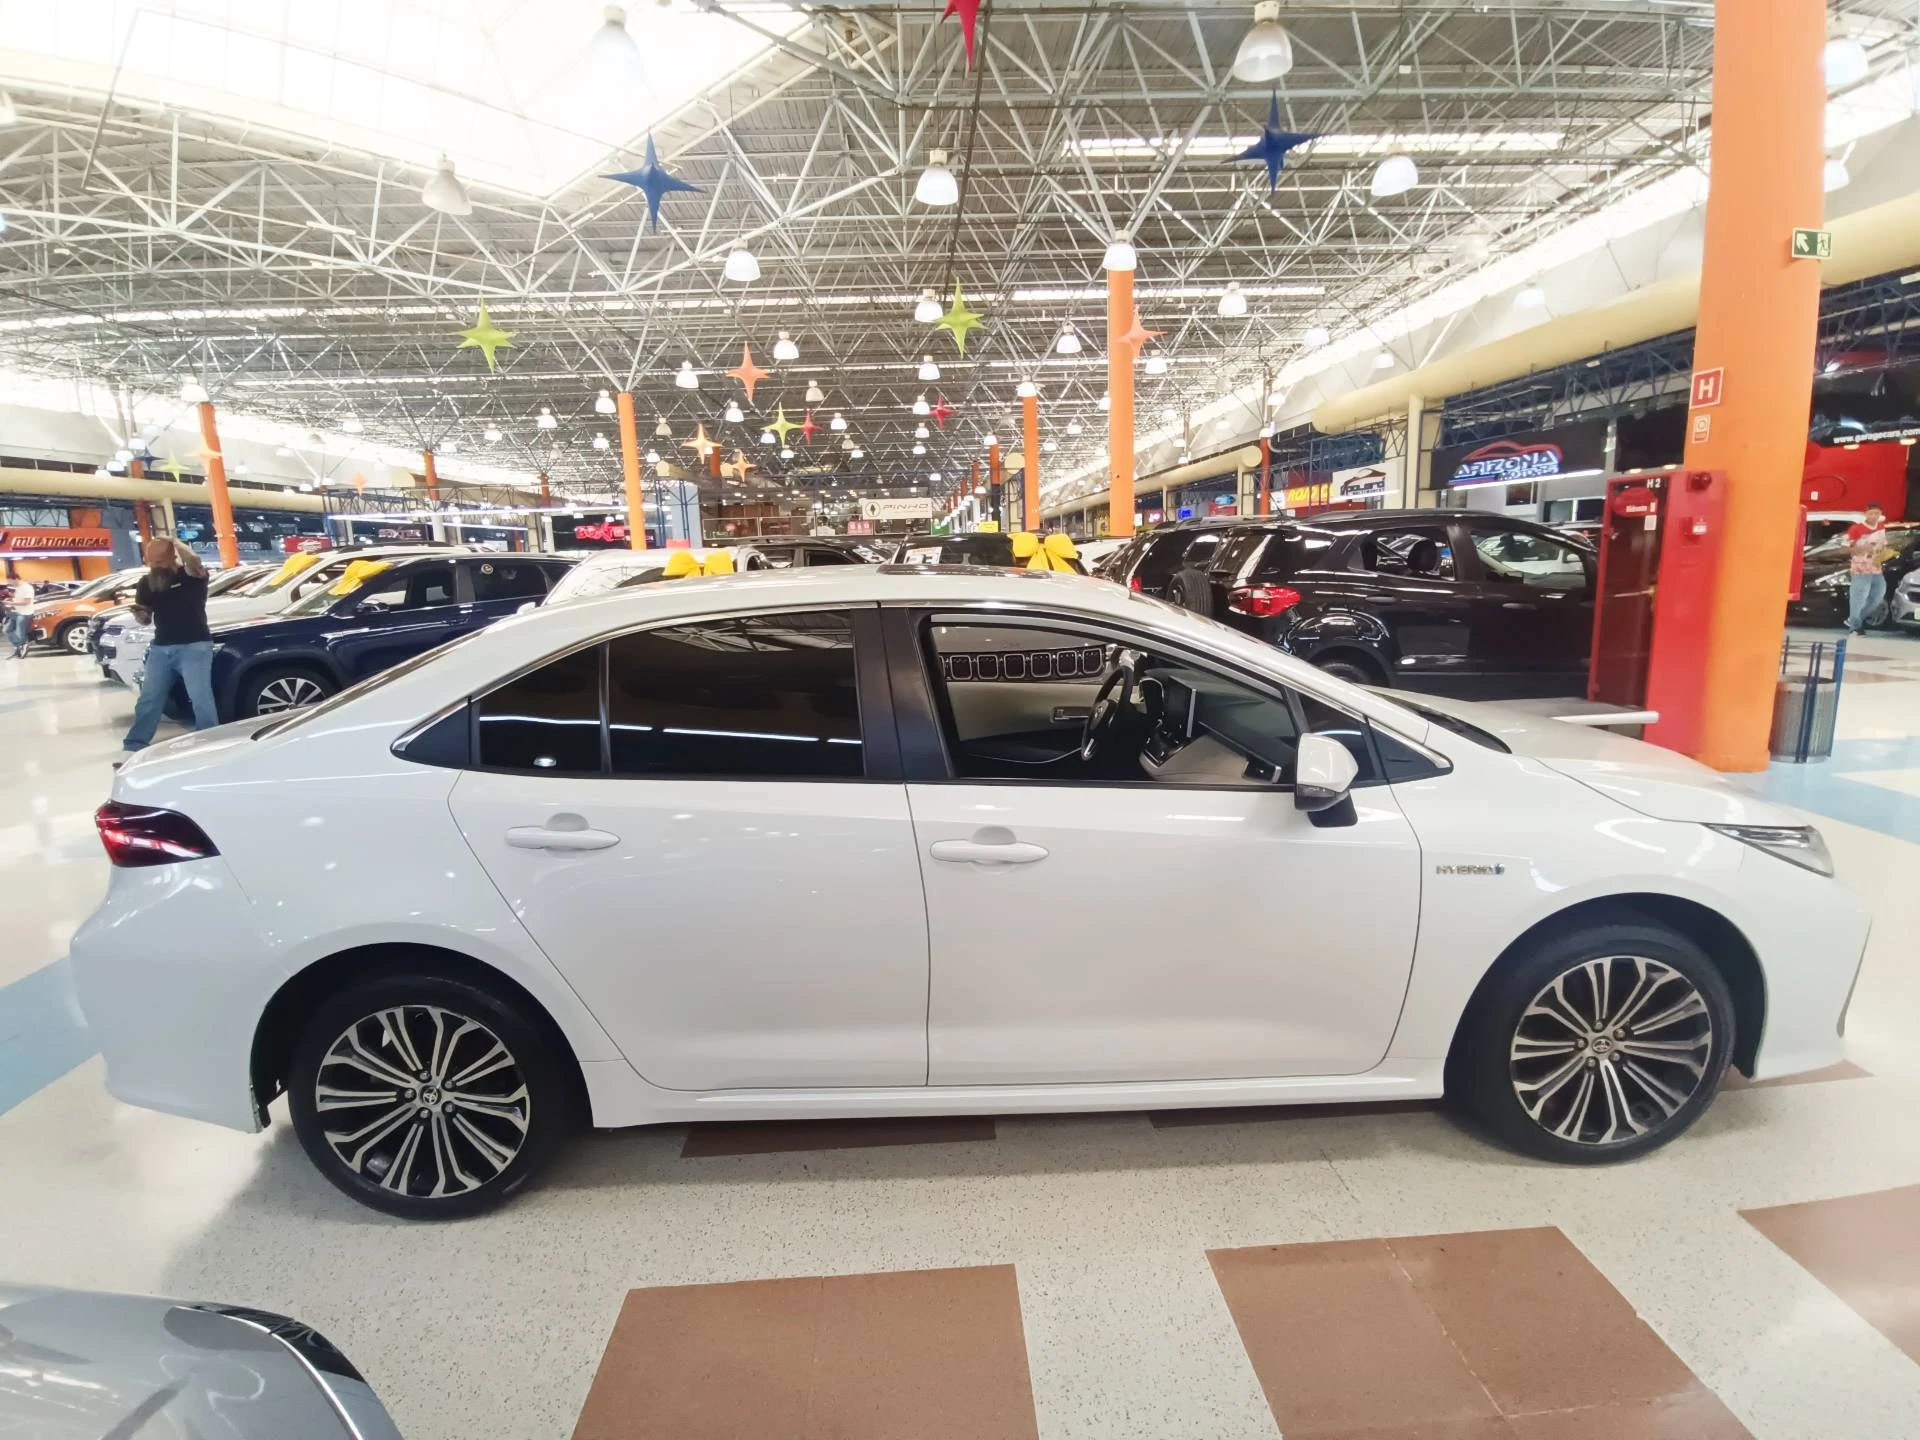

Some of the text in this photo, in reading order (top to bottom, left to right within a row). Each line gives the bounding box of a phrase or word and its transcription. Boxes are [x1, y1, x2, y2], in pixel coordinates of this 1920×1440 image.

[1697, 376, 1714, 400] H
[1453, 450, 1559, 478] ARIZONA
[882, 502, 929, 511] PINHO
[11, 535, 109, 548] MULTIMARCAS
